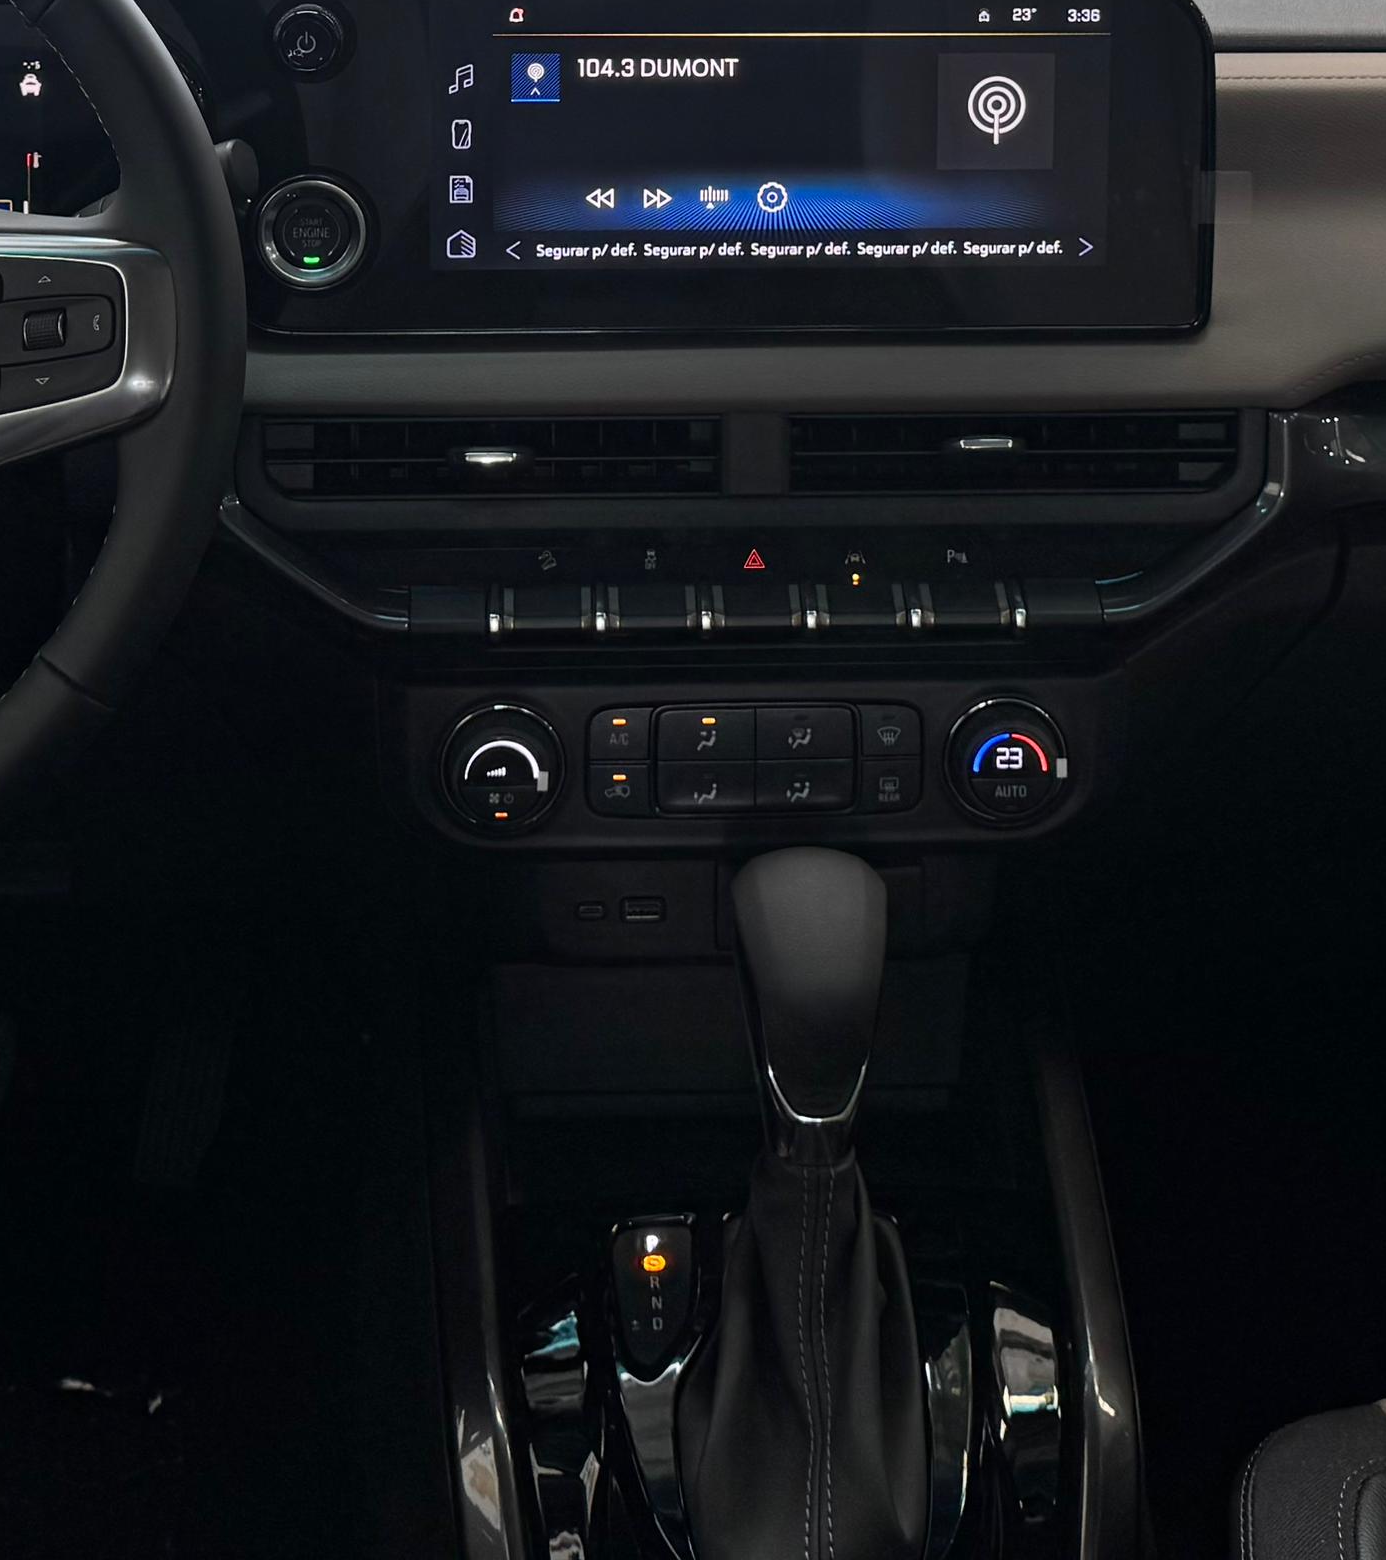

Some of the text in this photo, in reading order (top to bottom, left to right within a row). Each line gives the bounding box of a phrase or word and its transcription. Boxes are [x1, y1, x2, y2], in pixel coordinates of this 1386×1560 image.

[1067, 8, 1100, 23] 3:36
[576, 58, 739, 79] 104.3 DUMONT
[293, 227, 330, 238] ENGINE
[536, 242, 637, 259] Segurar p/ def.
[643, 242, 744, 259] Segurar p/ def.
[750, 242, 851, 259] Segurar p/ def.
[857, 242, 957, 259] Segurar p/ def.
[963, 242, 1063, 259] Segurar p/ def.
[609, 733, 629, 746] A/C
[995, 748, 1023, 770] 23
[994, 785, 1028, 798] AUTO
[646, 1234, 659, 1253] P
[650, 1275, 660, 1289] R
[652, 1295, 662, 1310] N
[653, 1316, 663, 1330] D
